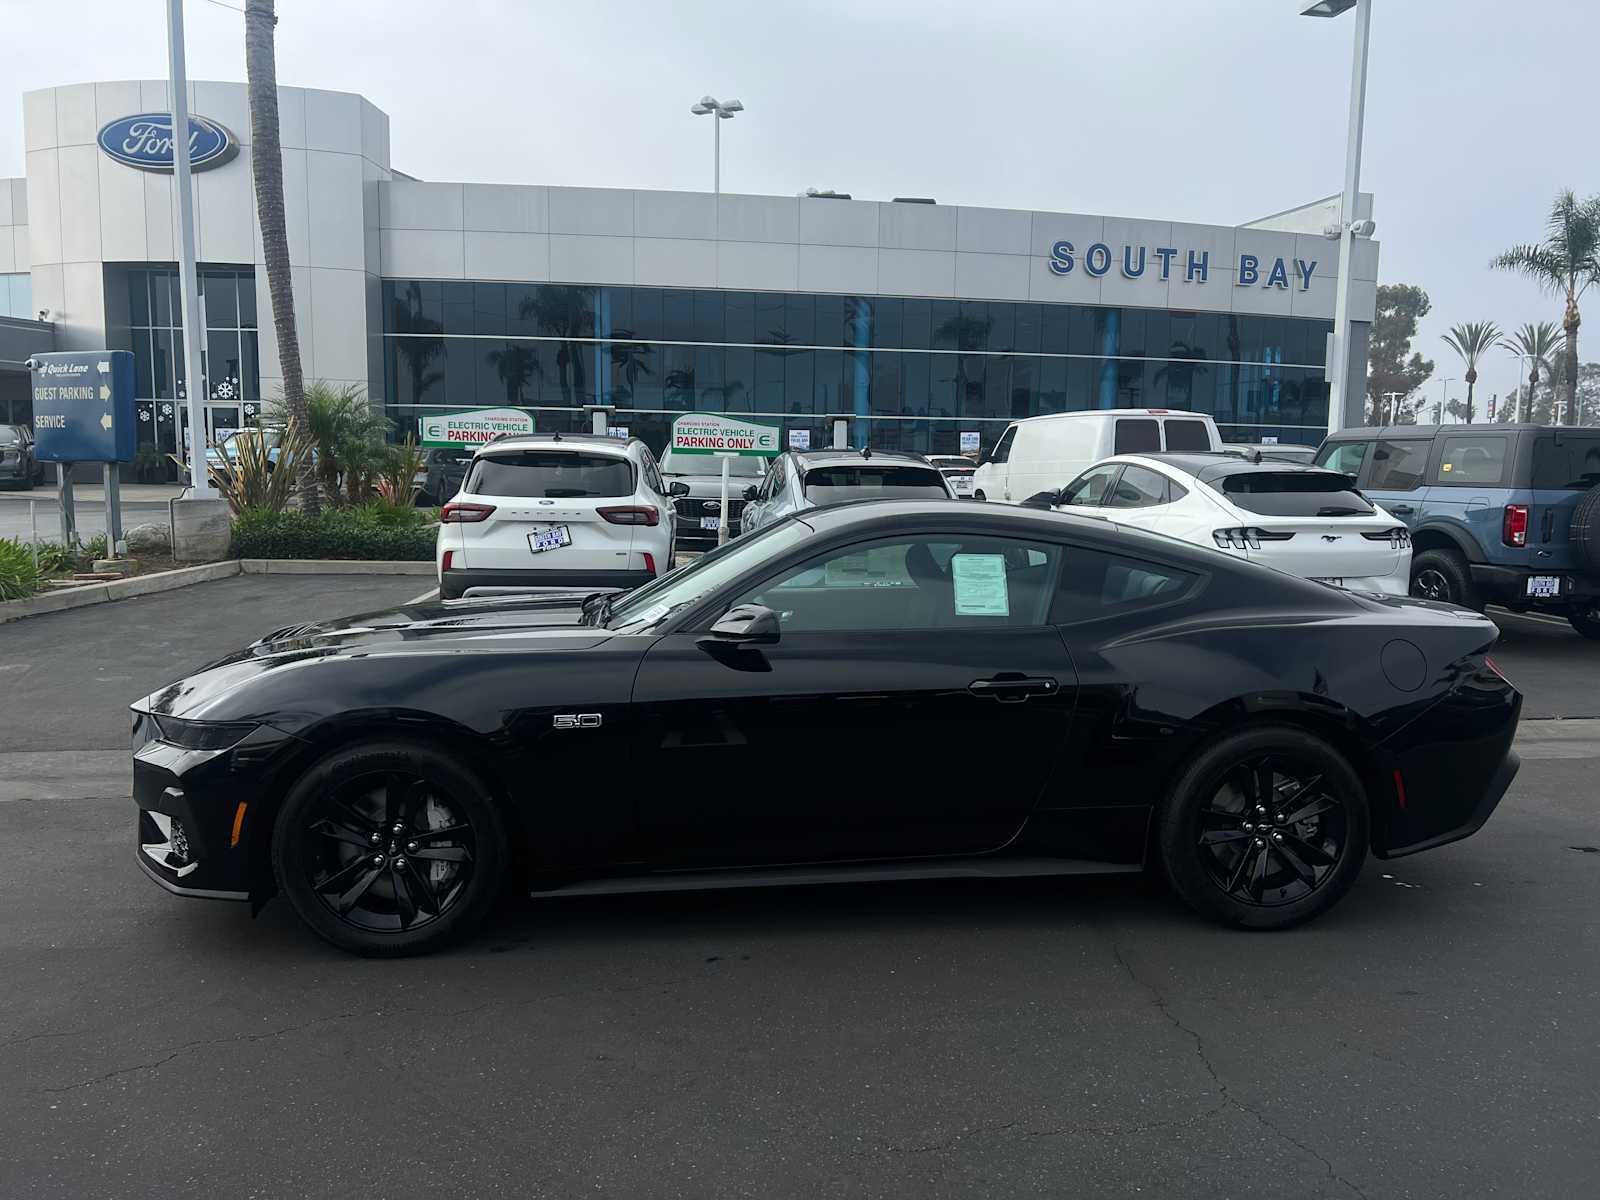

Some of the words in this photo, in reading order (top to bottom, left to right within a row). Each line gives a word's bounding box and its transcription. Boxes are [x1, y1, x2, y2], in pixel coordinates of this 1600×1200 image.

[1050, 240, 1209, 283] SOUTH
[1237, 254, 1318, 290] BAY
[48, 363, 68, 374] Quick
[69, 363, 88, 373] Lane
[34, 387, 57, 400] GUEST
[59, 386, 94, 400] PARKING
[35, 415, 66, 428] SERVICE
[448, 421, 490, 431] ELECTRIC
[492, 422, 528, 432] VEHICLE
[677, 427, 719, 437] ELECTRIC
[720, 428, 754, 437] VEHICLE
[676, 436, 724, 448] PARKING
[727, 438, 755, 449] ONLY
[553, 713, 602, 729] 5.0
